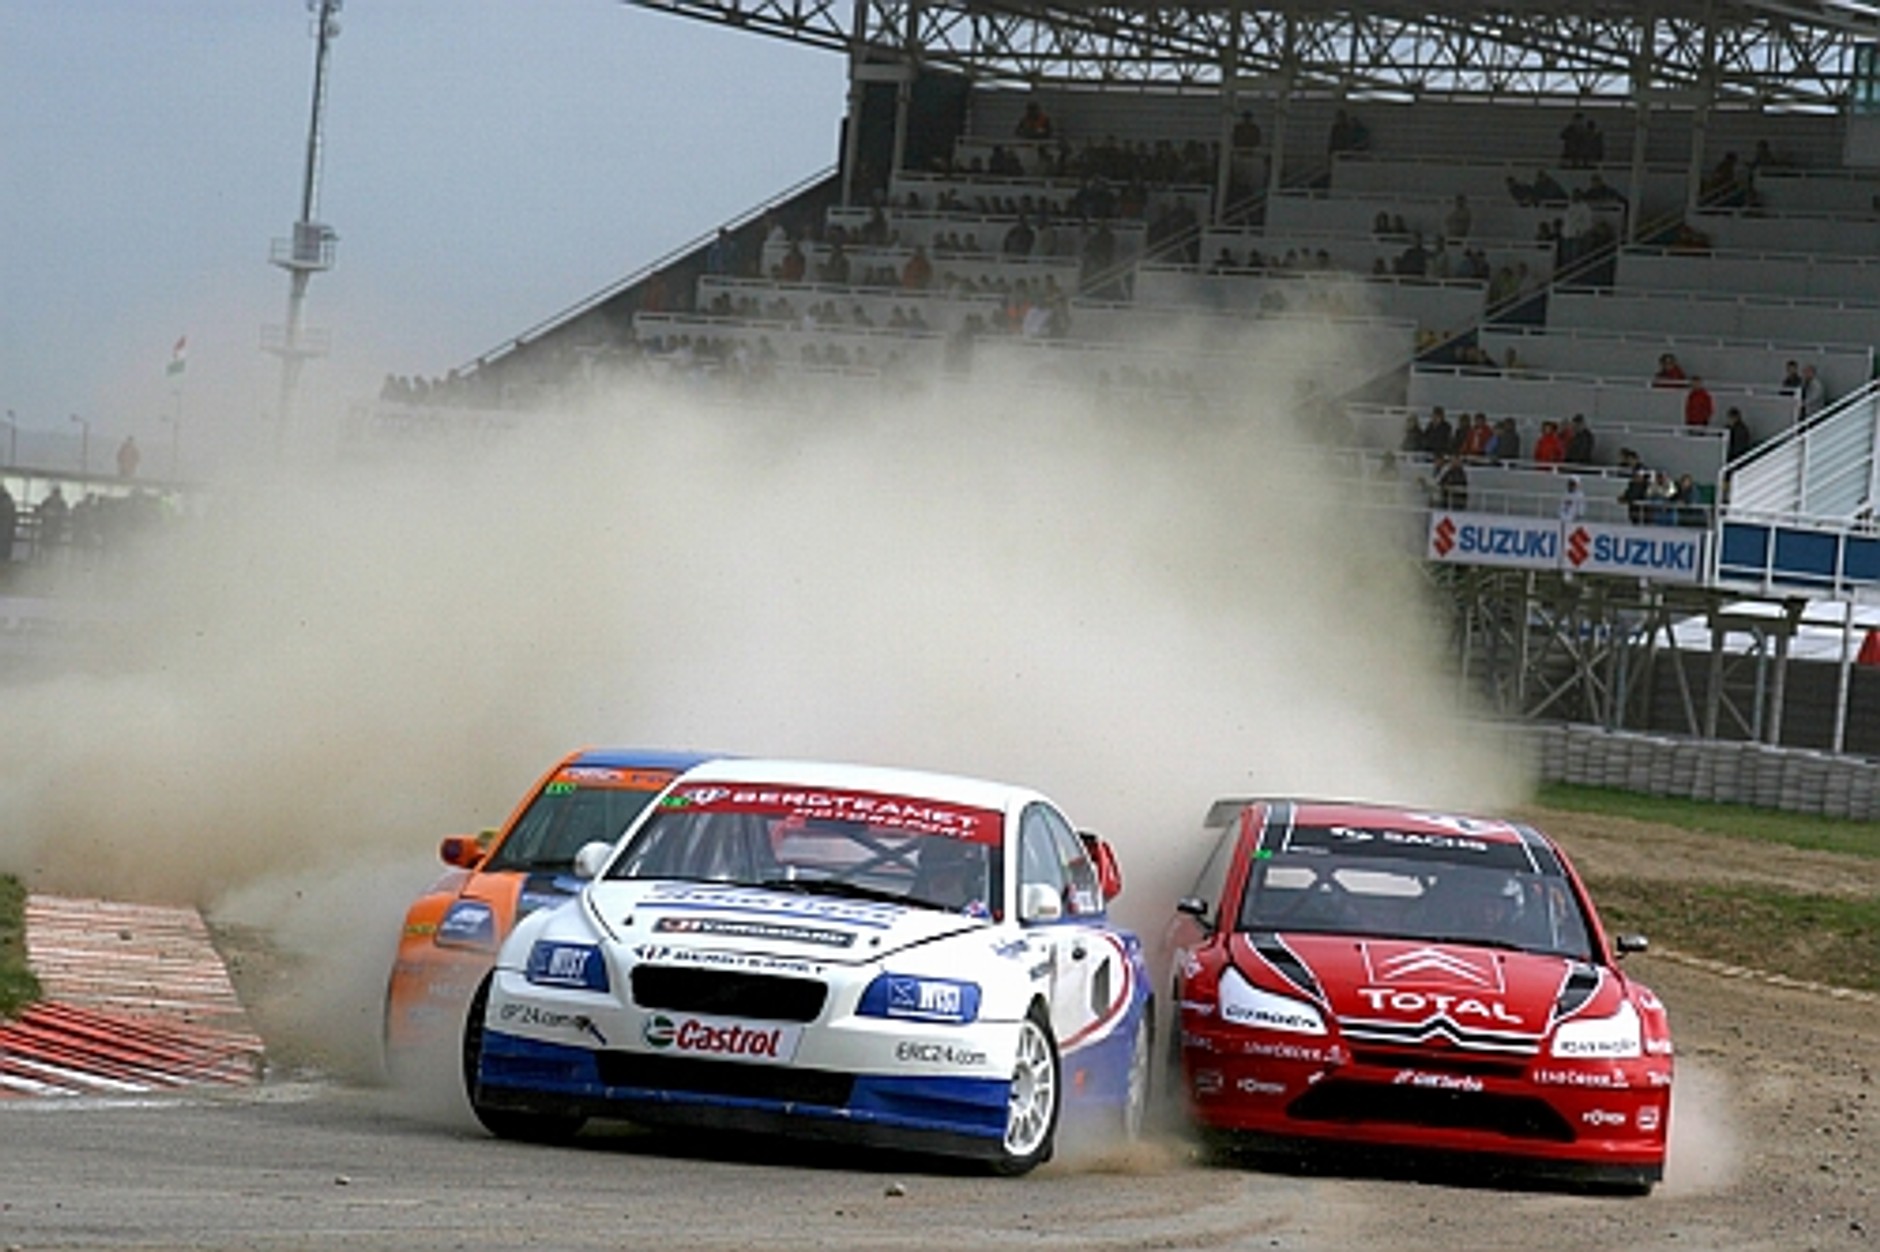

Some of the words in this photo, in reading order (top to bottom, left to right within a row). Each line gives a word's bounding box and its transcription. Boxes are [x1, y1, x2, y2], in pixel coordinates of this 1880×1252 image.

[1459, 525, 1557, 558] SUZUKI
[1594, 533, 1695, 570] SUZUKI
[1357, 987, 1524, 1025] TOTAL
[676, 1018, 782, 1057] Castrol
